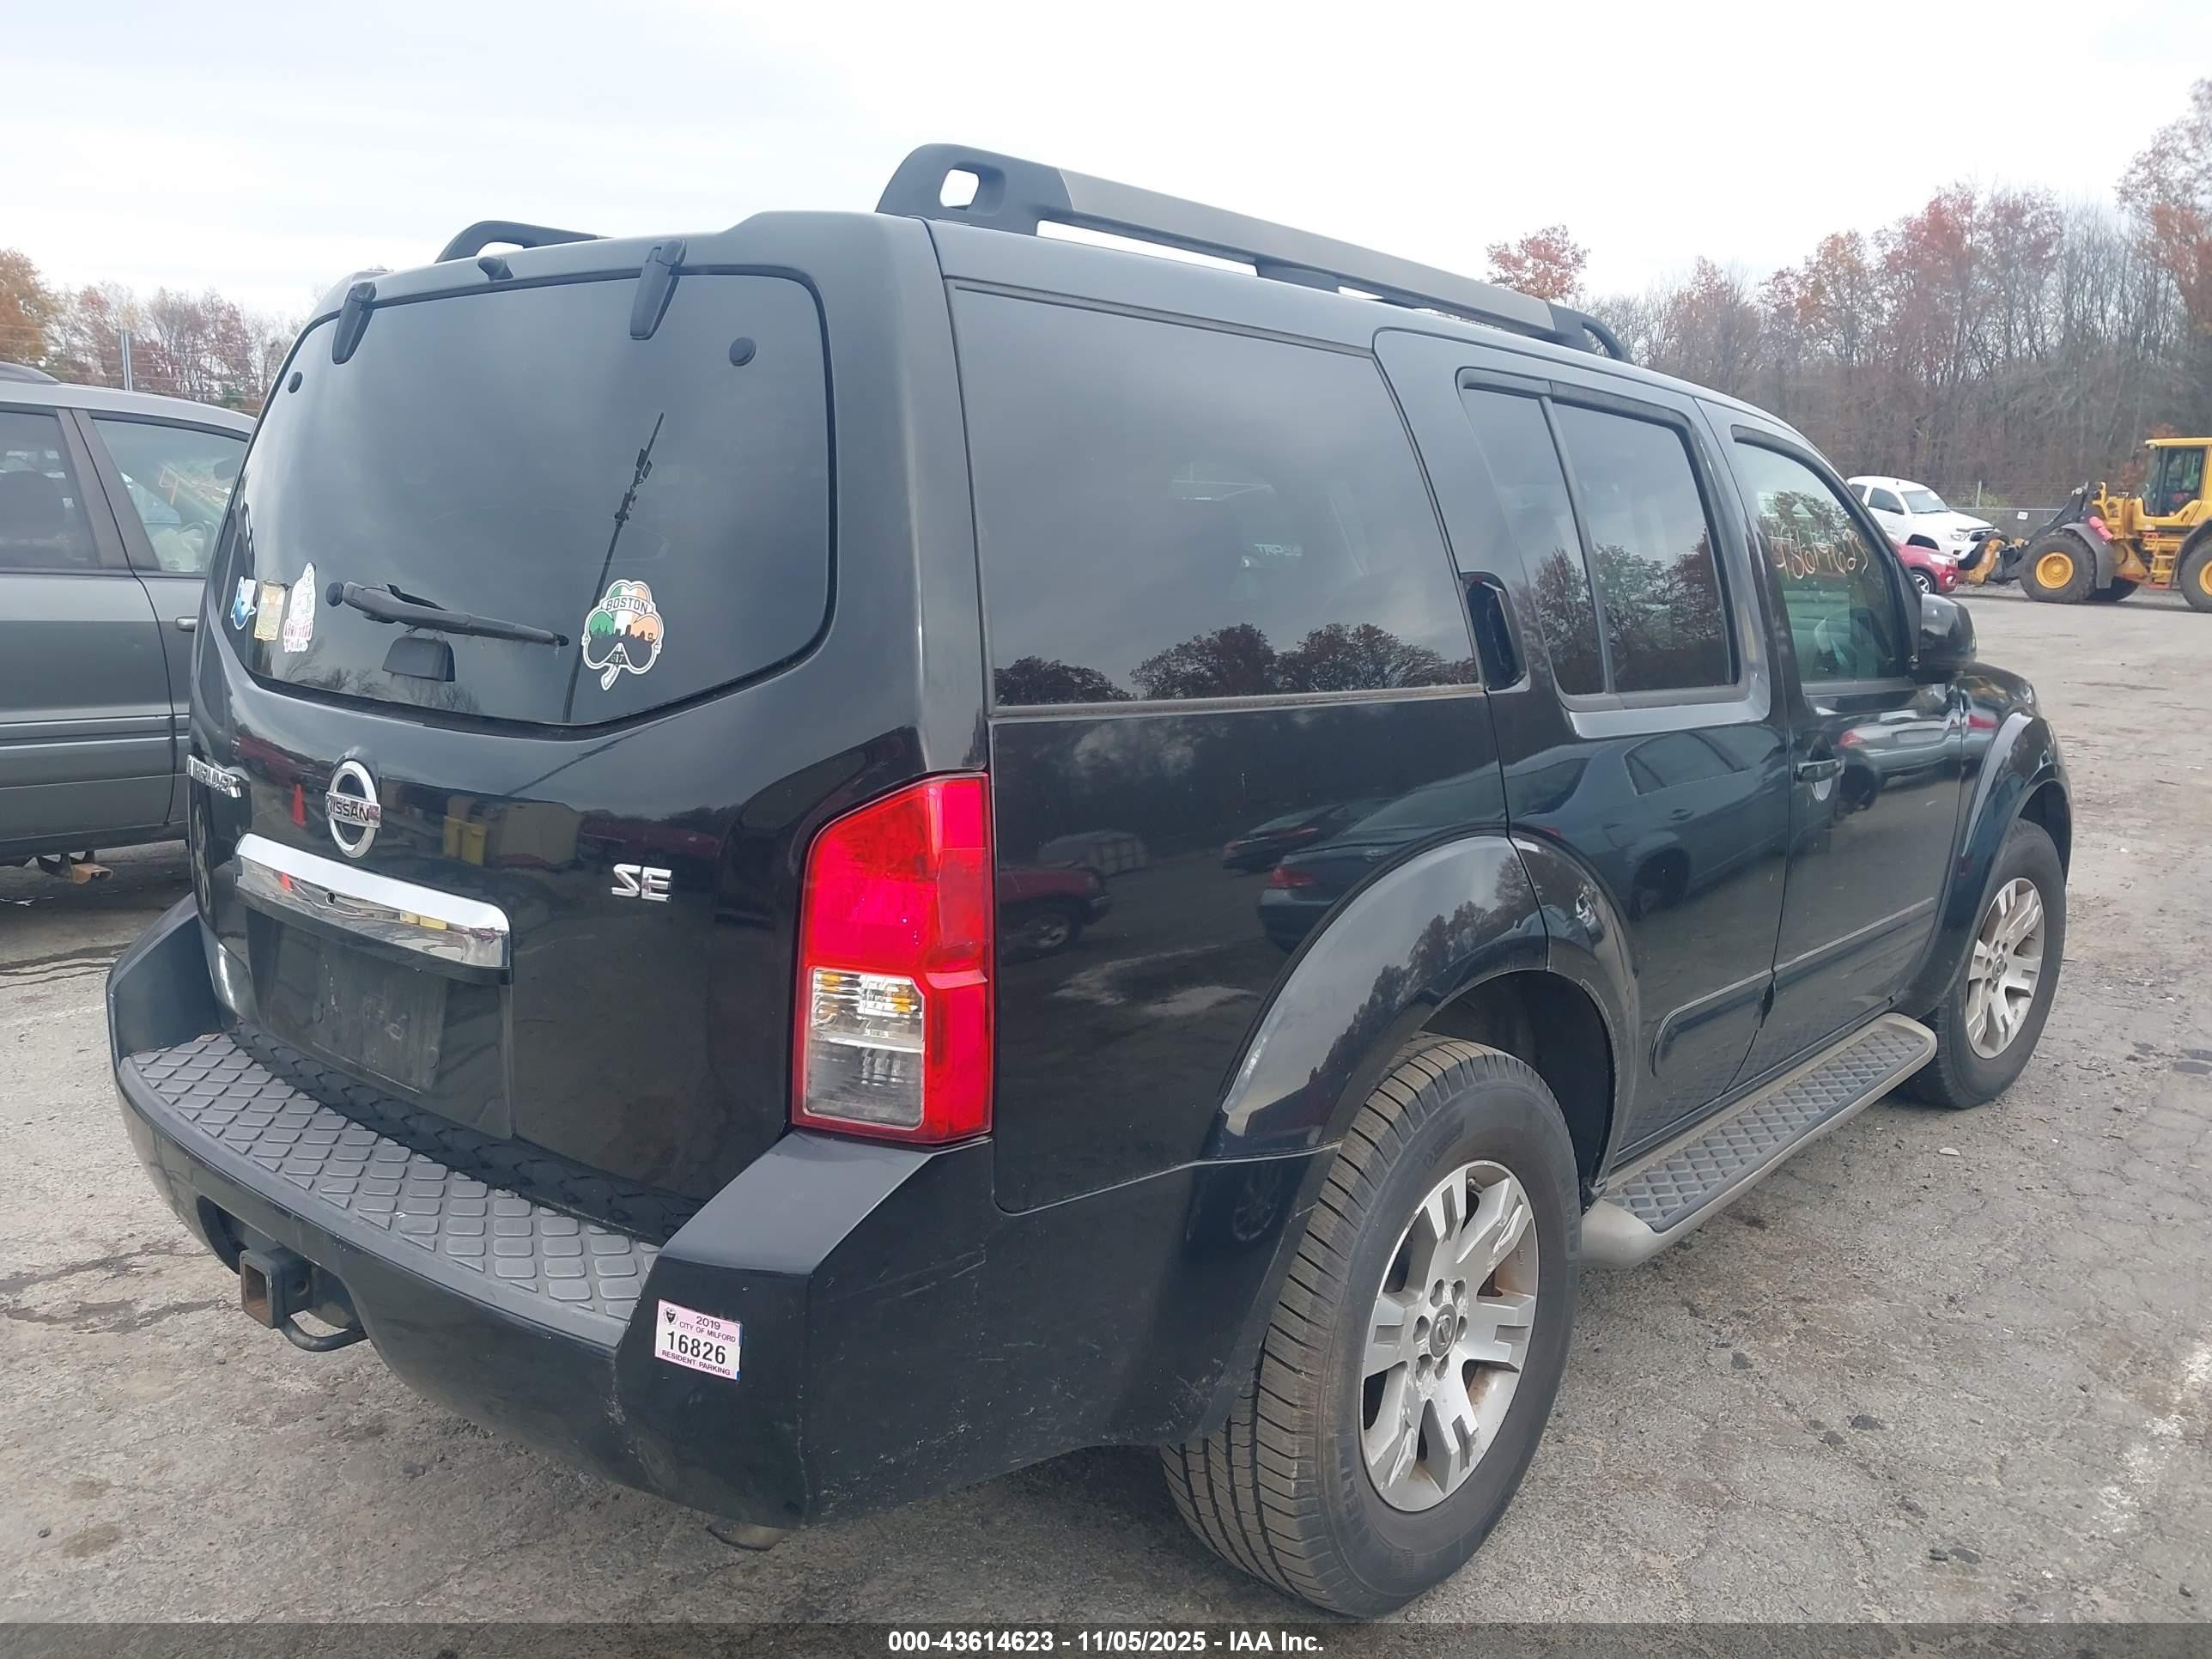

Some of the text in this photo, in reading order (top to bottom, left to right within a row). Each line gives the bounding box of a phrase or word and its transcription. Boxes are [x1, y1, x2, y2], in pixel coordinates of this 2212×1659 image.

[605, 597, 648, 613] BOSTON
[327, 799, 369, 822] NISSAN
[611, 863, 673, 902] SE
[679, 1321, 736, 1343] CITY OF MILFORD
[696, 1316, 721, 1330] 2019
[667, 1330, 726, 1364] 16826
[661, 1349, 731, 1376] RESIDENT PARKING
